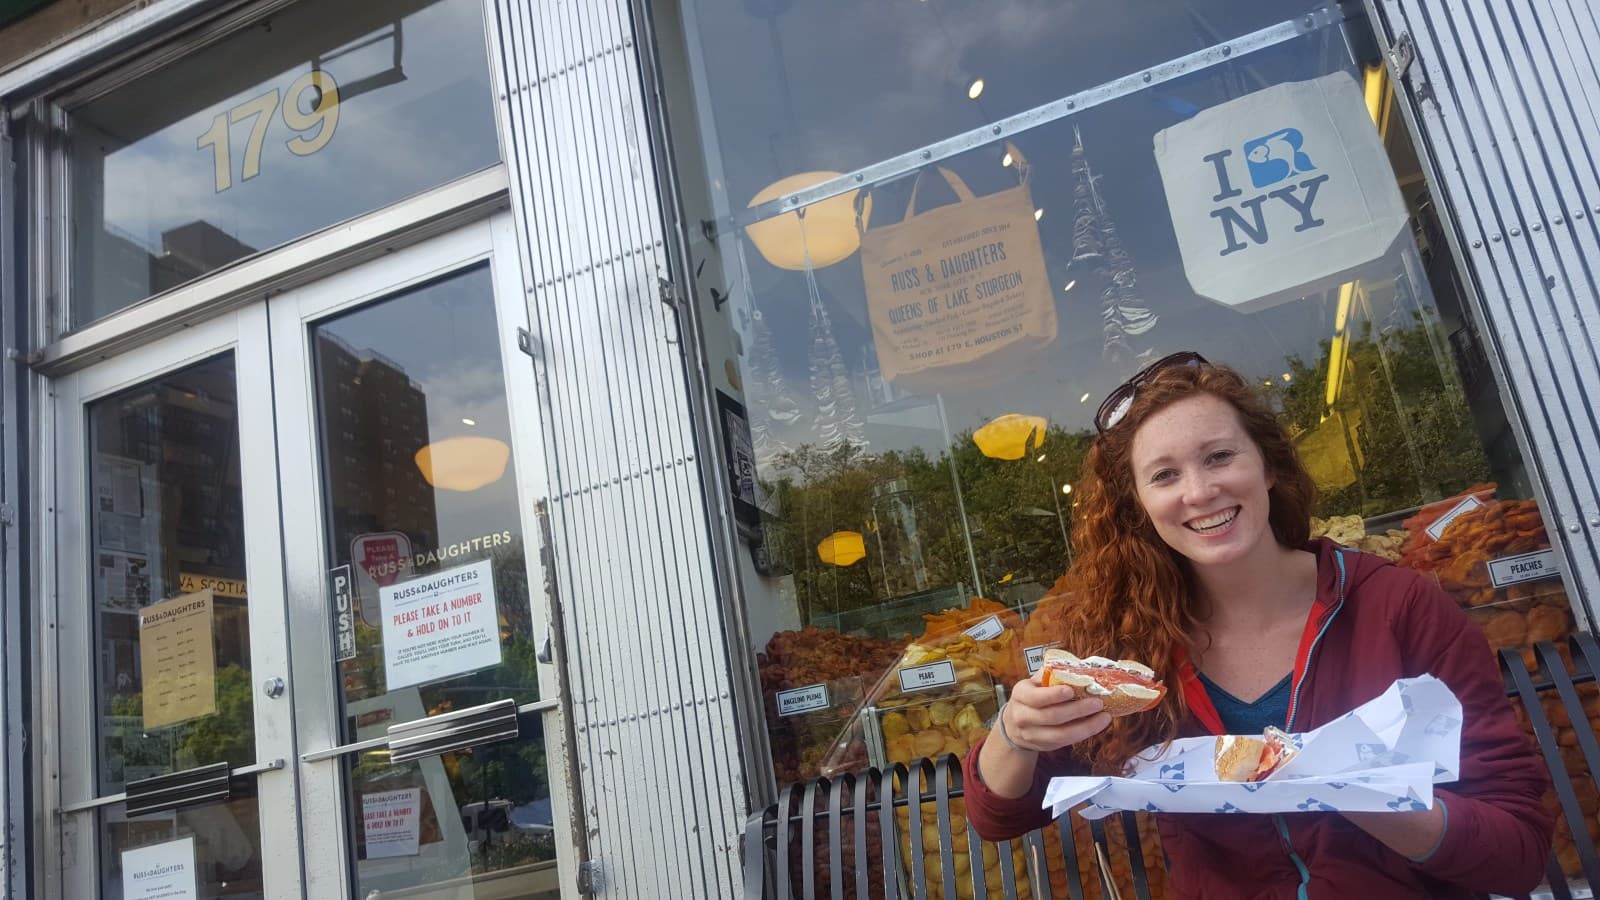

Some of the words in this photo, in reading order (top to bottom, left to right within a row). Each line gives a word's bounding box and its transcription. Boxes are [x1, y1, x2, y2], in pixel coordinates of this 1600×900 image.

[196, 70, 341, 194] 179
[1203, 149, 1243, 202] I
[1210, 174, 1329, 256] NY
[891, 267, 921, 292] RUSS
[925, 263, 935, 283] &
[939, 241, 1007, 279] DAUGHTERS
[888, 302, 923, 325] QUEENS
[928, 296, 938, 314] OF
[945, 287, 970, 309] LAKE
[975, 270, 1023, 300] STURGEON
[909, 350, 933, 361] SHOP
[935, 347, 944, 356] AT
[946, 343, 962, 353] 179
[975, 327, 1013, 345] HOUSTON
[1510, 560, 1543, 574] PEACHES
[200, 578, 247, 595] SCOTIA
[393, 570, 479, 600] RUSS&DAUGHTERS
[335, 575, 351, 652] PUSH
[393, 609, 419, 626] PLEASE
[422, 604, 441, 619] TAKE
[443, 602, 449, 613] A
[451, 593, 482, 610] NUMBER
[407, 629, 414, 638] &
[416, 622, 436, 637] HOLD
[438, 618, 449, 631] ON
[452, 614, 462, 627] TO
[464, 611, 472, 623] IT
[972, 628, 987, 639] ANGO
[918, 671, 935, 682] PEARS
[783, 695, 806, 706] ANGELINO
[806, 692, 822, 701] PLUMS
